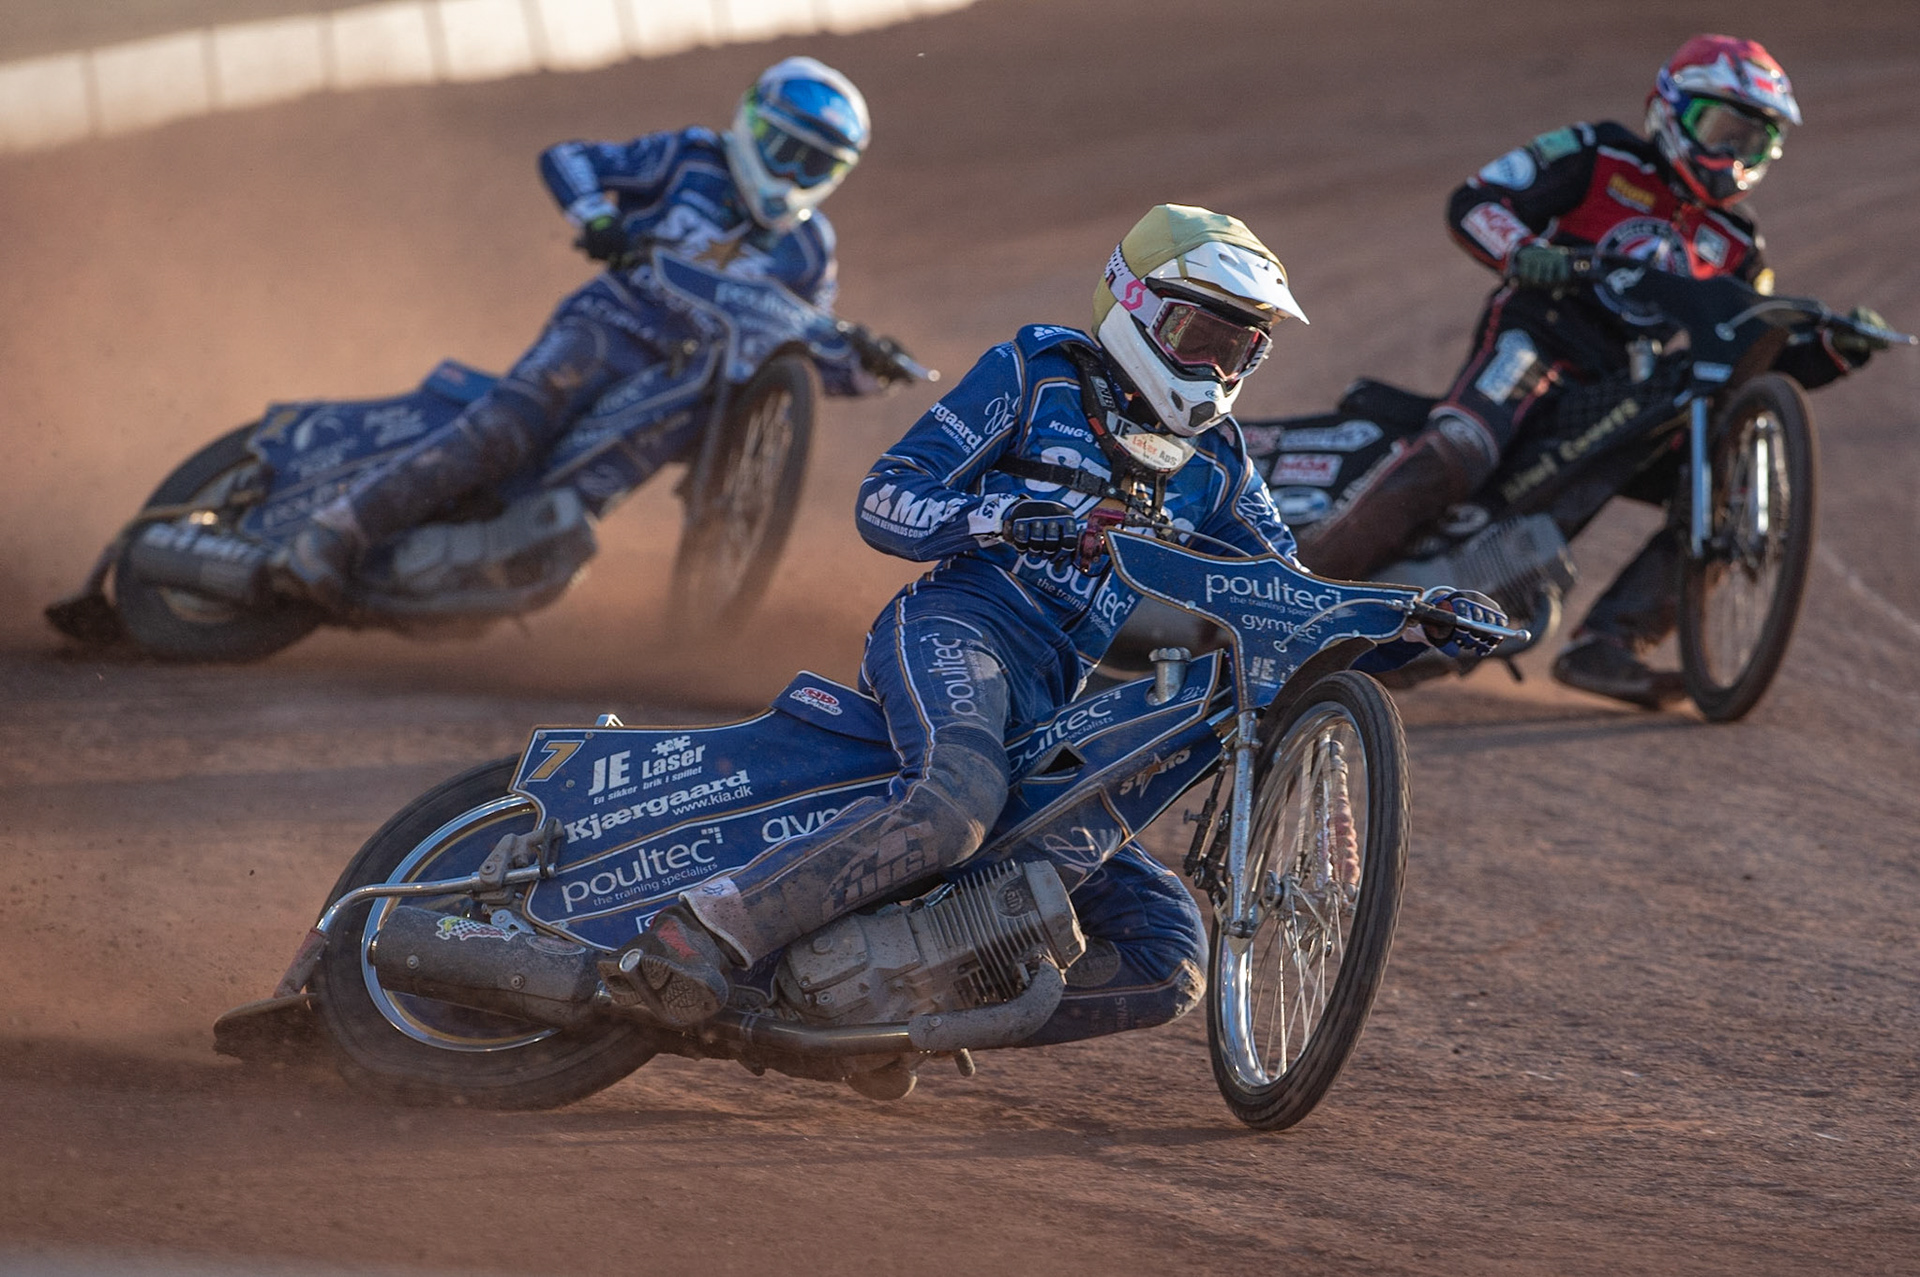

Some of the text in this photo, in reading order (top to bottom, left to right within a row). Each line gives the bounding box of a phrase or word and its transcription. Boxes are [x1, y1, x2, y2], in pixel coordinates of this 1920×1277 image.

[930, 401, 983, 451] rgaard
[1048, 420, 1093, 443] KING'S
[1112, 418, 1132, 440] JE
[880, 519, 908, 536] REYNOLDS
[1037, 578, 1057, 593] the
[1056, 586, 1091, 614] traini
[1206, 573, 1333, 614] poultec
[1229, 595, 1335, 624] the training specists
[928, 638, 989, 722] poultec
[1248, 656, 1276, 681] JE
[525, 740, 586, 782] 7
[588, 745, 705, 796] JE Laser
[593, 796, 605, 805] En
[607, 785, 638, 801] sikker
[643, 778, 663, 790] brik
[672, 766, 702, 782] spillet
[672, 785, 754, 816] www.kia.dk
[564, 769, 750, 844] Kjærgaard
[561, 838, 716, 913] poultec
[593, 862, 718, 906] the training specialists
